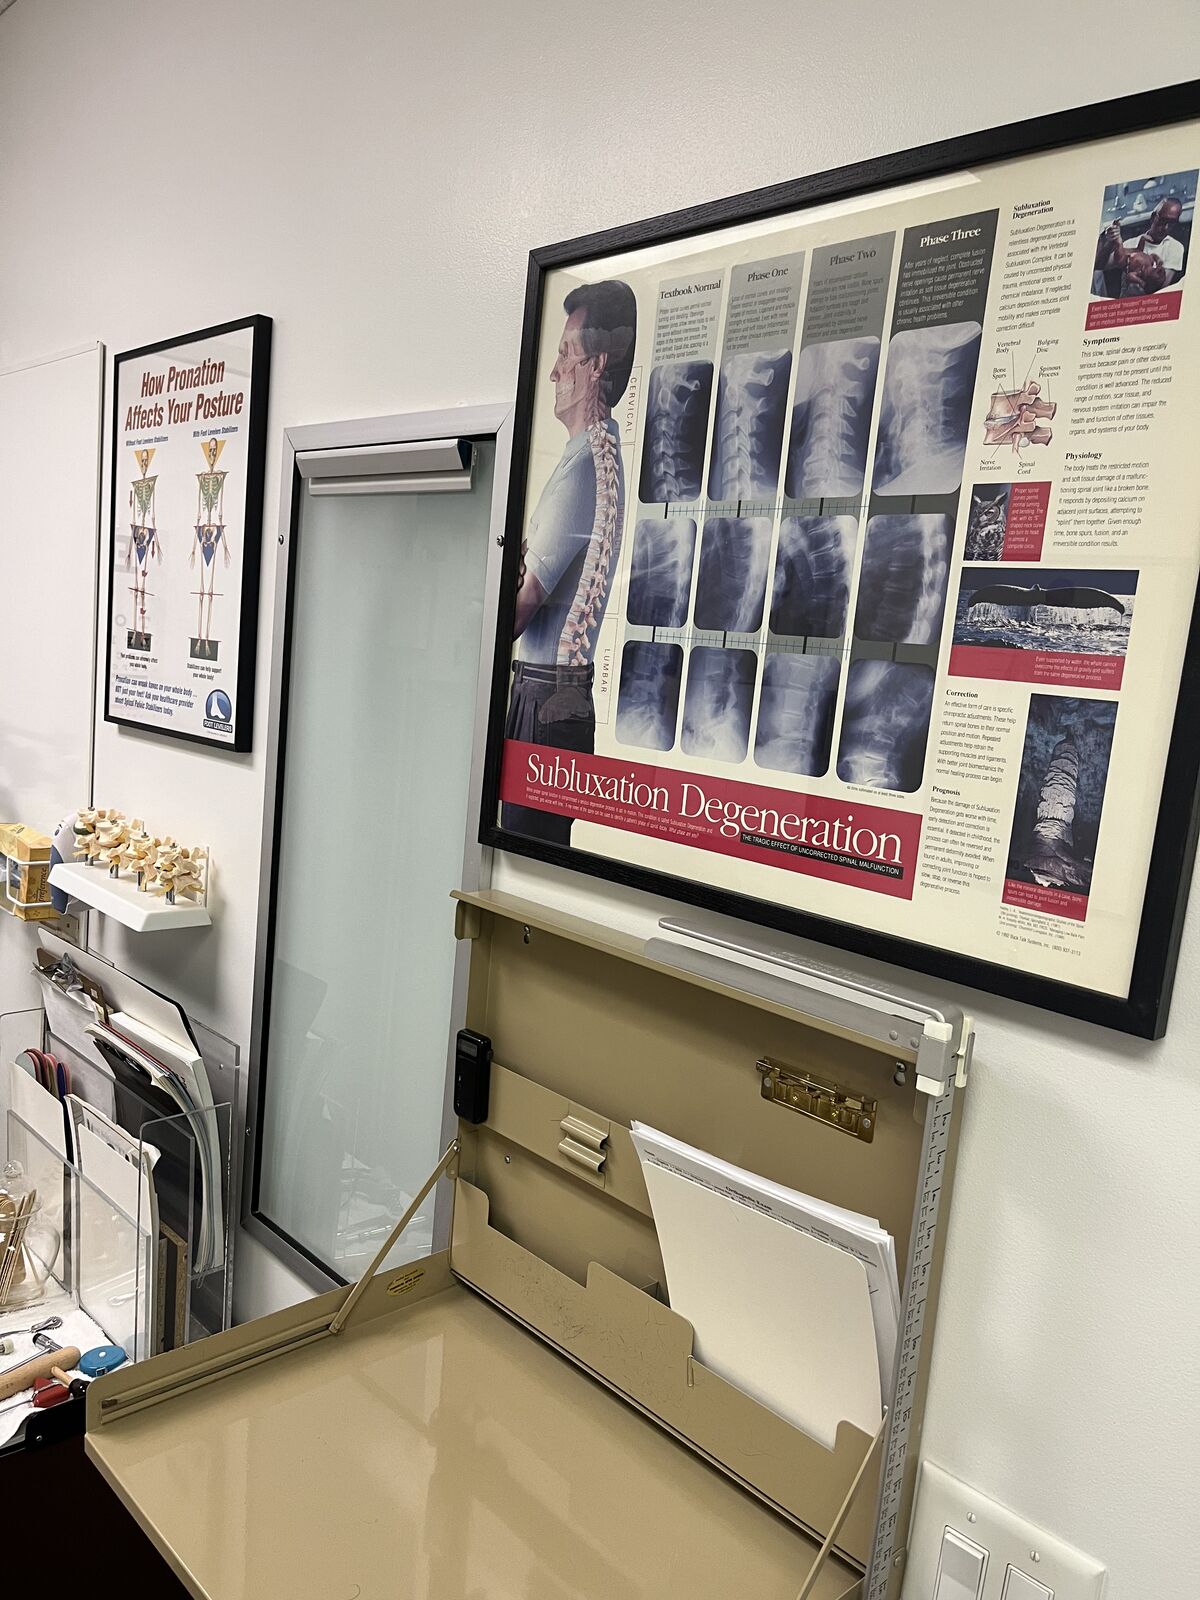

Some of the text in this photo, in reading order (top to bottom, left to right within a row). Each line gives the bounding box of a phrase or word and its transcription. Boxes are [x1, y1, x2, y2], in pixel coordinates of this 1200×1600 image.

[1012, 206, 1054, 220] Degeneration
[1013, 200, 1051, 214] Subluxation
[1010, 226, 1036, 237] Subluxation
[1036, 220, 1066, 231] Degeneration
[920, 228, 981, 248] Phase Three
[1008, 230, 1077, 247] relentless degenerative process
[1007, 247, 1031, 258] associated
[1048, 239, 1069, 250] Vertebral
[830, 250, 877, 266] Phase Two
[747, 268, 789, 283] Phase One
[660, 279, 721, 300] Textbook Normal
[997, 339, 1022, 348] Vertebral
[1037, 339, 1059, 347] Bulging
[1082, 337, 1120, 348] Symptoms
[1092, 348, 1105, 358] slow,
[1105, 347, 1121, 356] spinal
[1142, 343, 1168, 352] especially
[1039, 365, 1061, 373] Spinous
[1079, 360, 1097, 369] serious
[1097, 360, 1118, 368] because
[1117, 358, 1130, 367] pain
[1136, 356, 1150, 364] other
[140, 357, 225, 398] How Pronation
[993, 367, 1007, 375] Bone
[1078, 373, 1102, 382] symptoms
[1114, 369, 1123, 377] not
[1130, 367, 1150, 377] present
[1149, 366, 1162, 374] until
[124, 390, 244, 432] Affects Your Posture
[625, 377, 637, 433] CERVICAL
[1065, 452, 1103, 461] Physiology
[1018, 461, 1036, 469] Spinal
[1072, 462, 1086, 473] body
[601, 648, 611, 693] LUMBAR
[946, 689, 979, 698] Correction
[932, 785, 961, 796] Prognosis
[526, 753, 669, 812] Subluxation
[681, 783, 903, 863] Degeneration
[930, 796, 947, 805] Because
[954, 801, 971, 810] damage
[975, 804, 1001, 814] Subluxation
[742, 834, 752, 842] THE
[752, 836, 771, 846] TRAGIC
[770, 840, 790, 850] EFFECT
[798, 847, 839, 862] UNCORRECTED
[838, 856, 858, 866] SPINAL
[859, 860, 900, 875] MALFUNCTION
